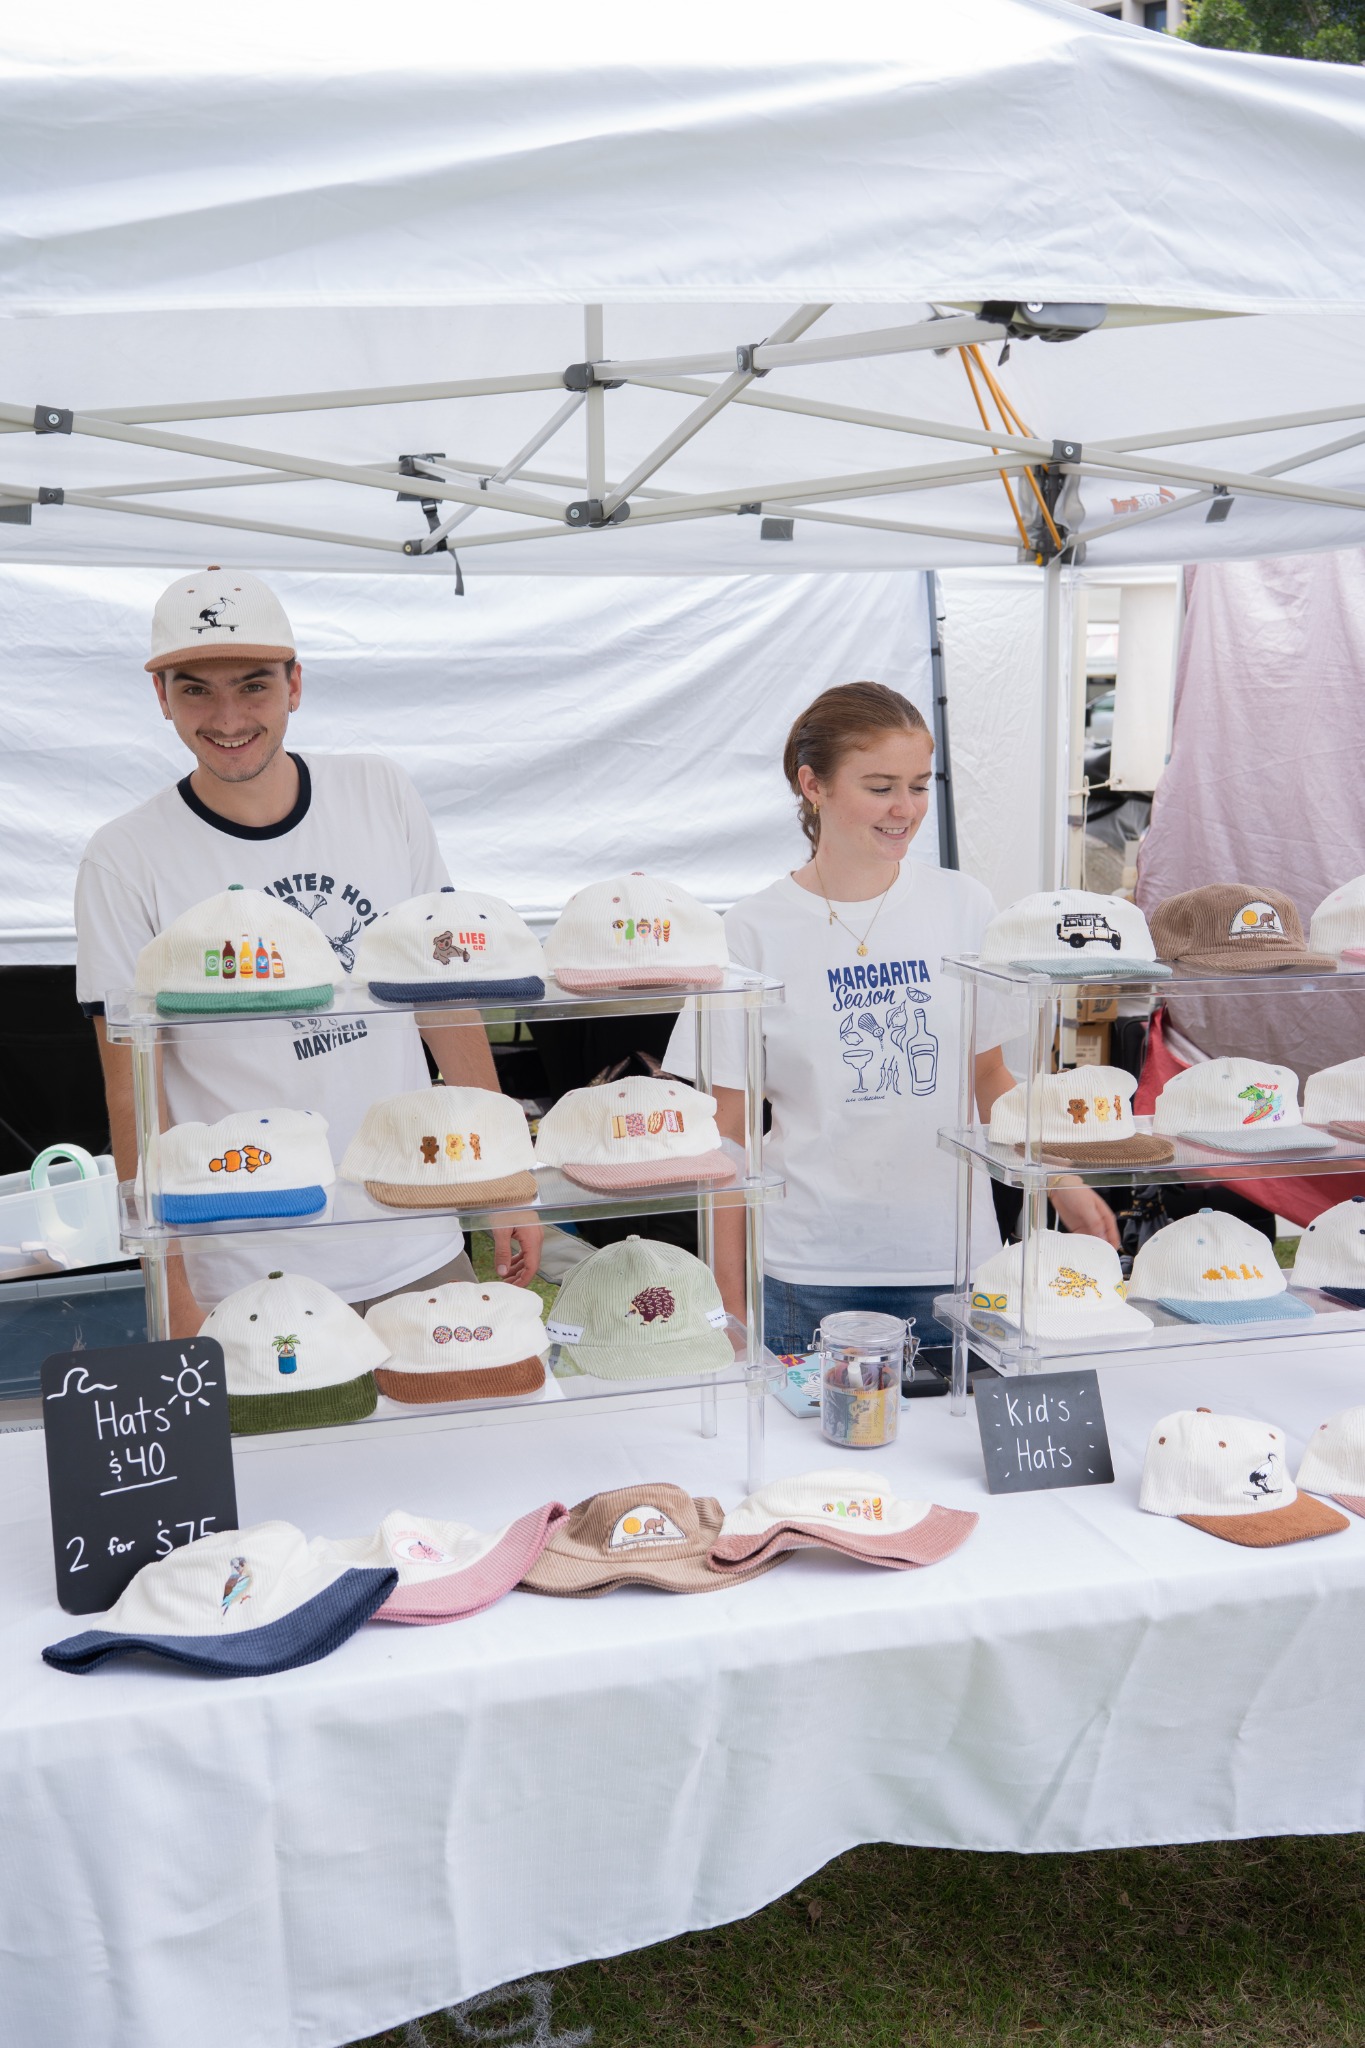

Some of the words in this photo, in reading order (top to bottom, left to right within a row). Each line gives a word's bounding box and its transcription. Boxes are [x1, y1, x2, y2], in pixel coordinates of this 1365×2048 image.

[459, 932, 486, 945] LIES
[827, 960, 931, 992] MARGARITA
[833, 984, 896, 1012] Season
[94, 1397, 171, 1440] Hats
[1006, 1393, 1070, 1426] Kid's
[109, 1442, 166, 1482] $40
[1016, 1435, 1072, 1471] Hats
[66, 1536, 90, 1573] 2
[107, 1537, 136, 1556] for
